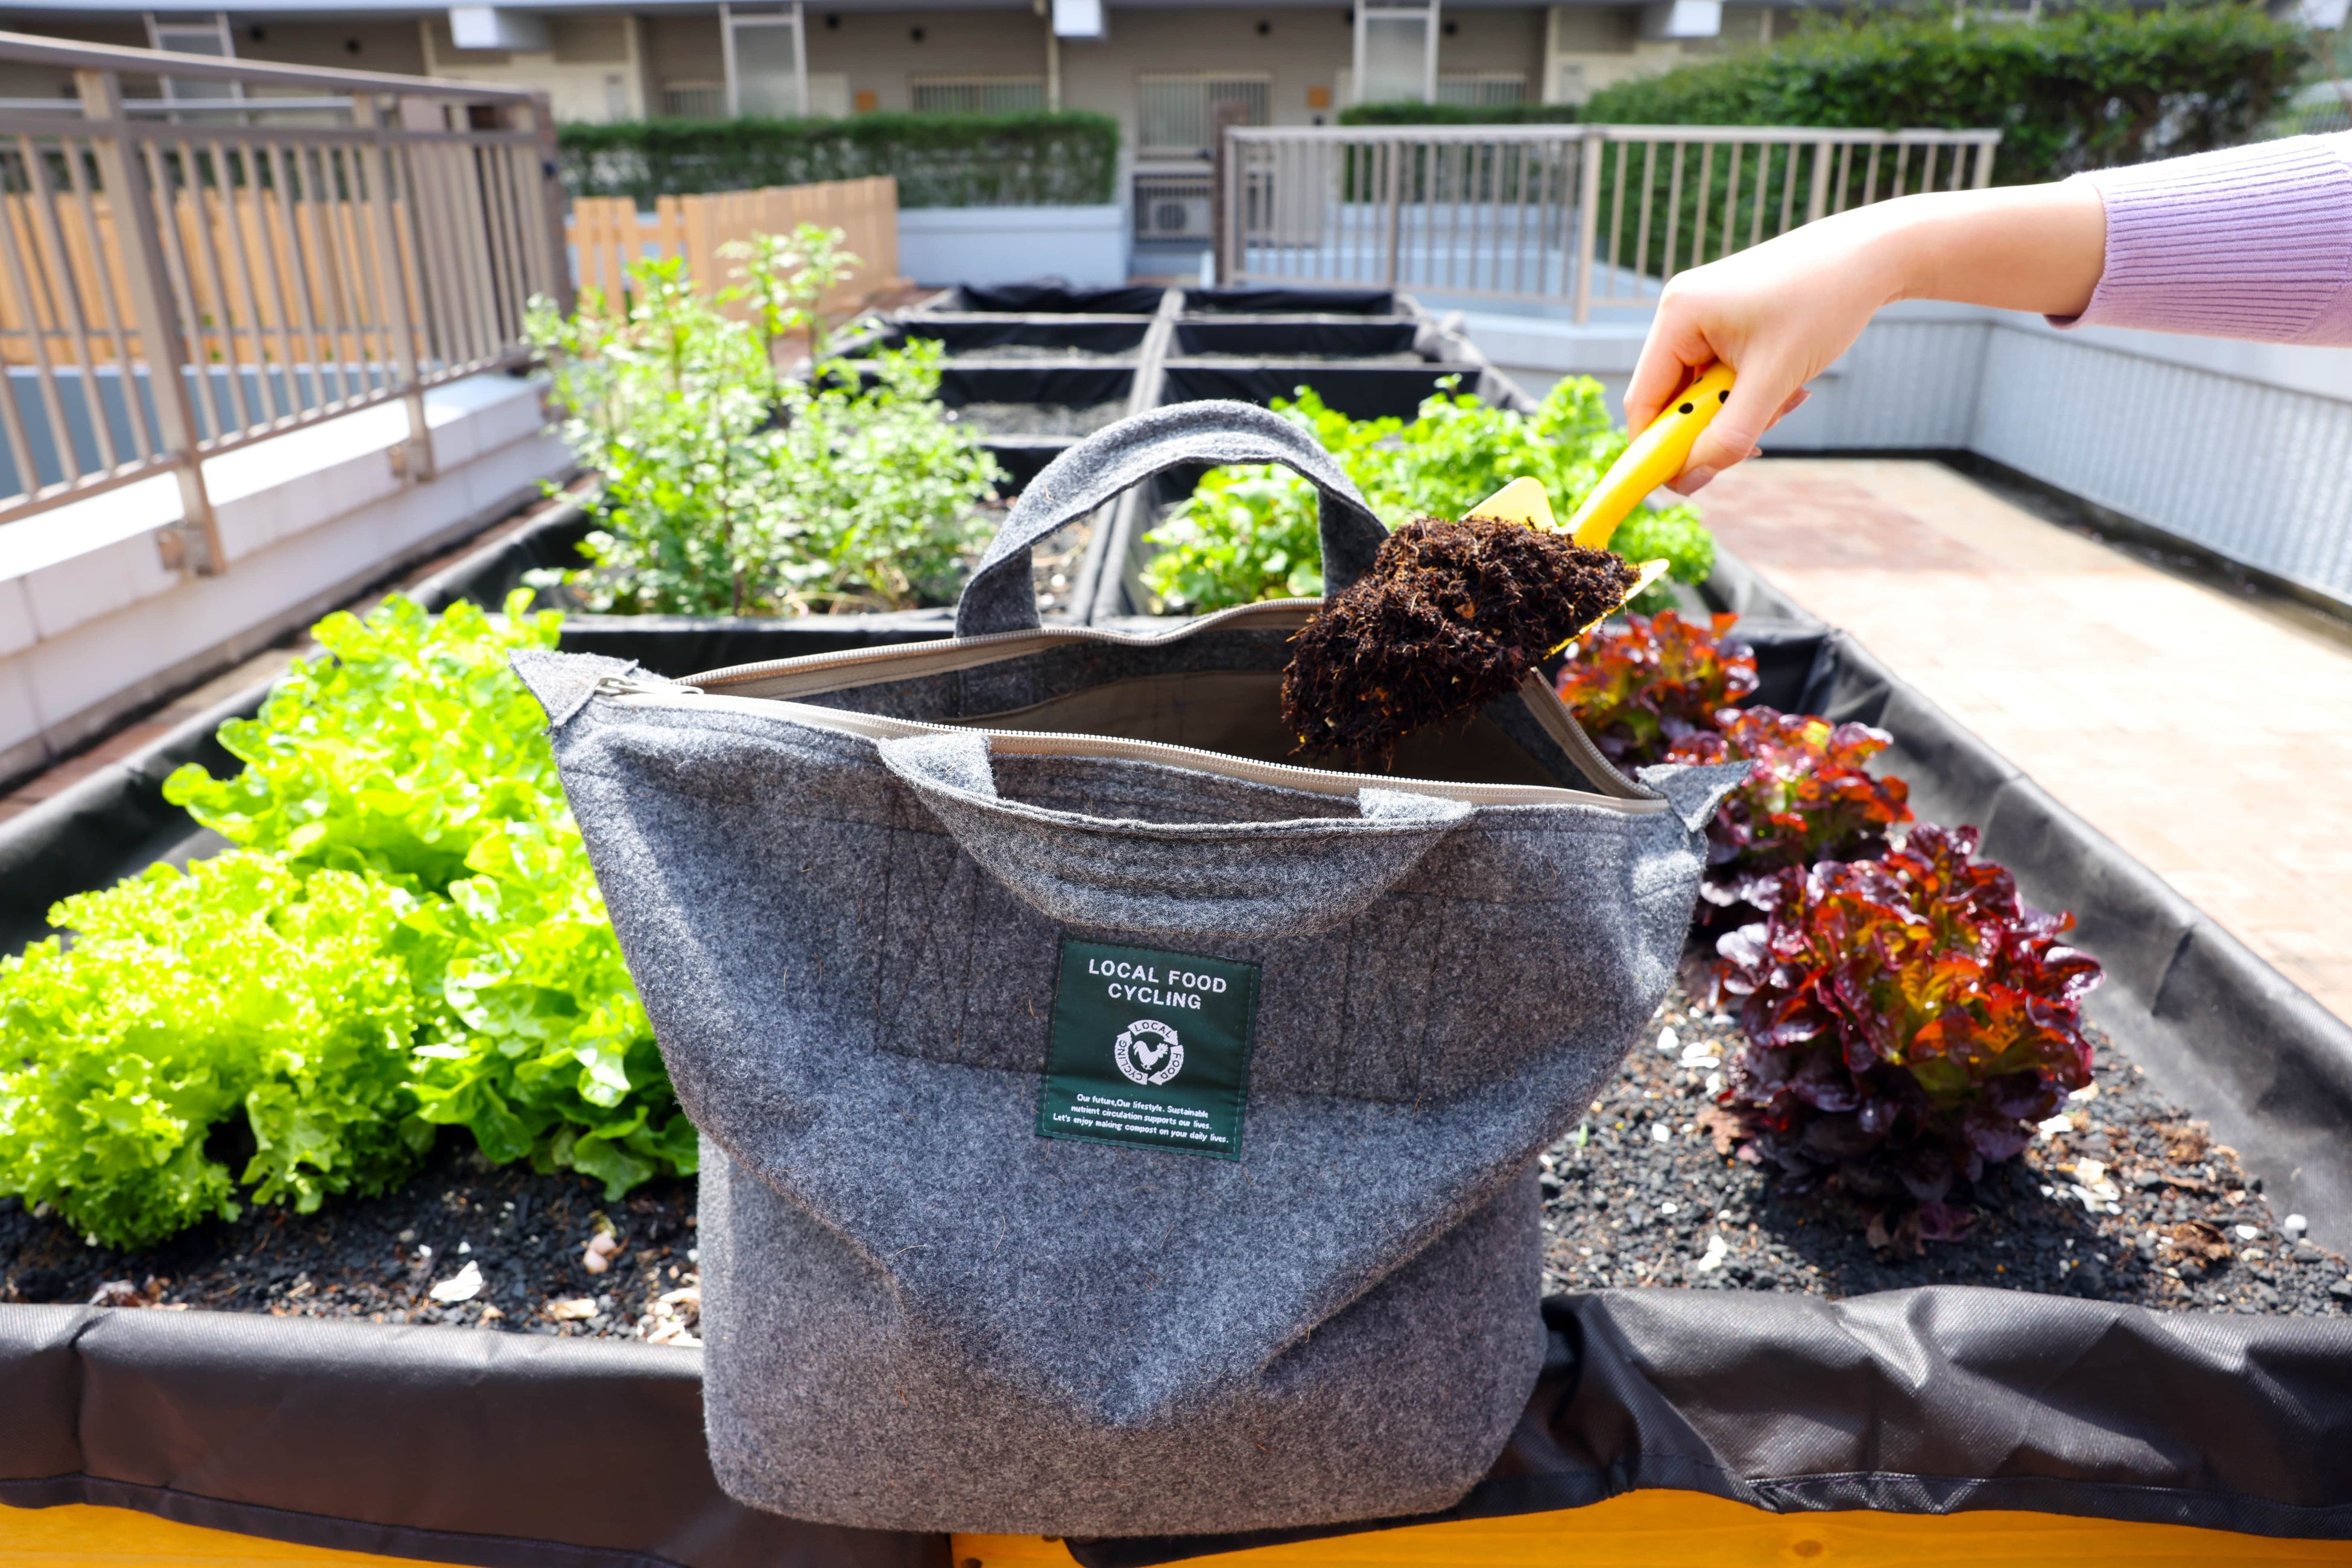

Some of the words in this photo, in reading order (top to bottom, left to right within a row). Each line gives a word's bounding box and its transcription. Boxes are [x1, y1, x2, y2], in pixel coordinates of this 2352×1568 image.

[1089, 958, 1159, 984] LOCAL
[1168, 970, 1227, 993] FOOD
[1108, 982, 1201, 1010] CYCLING
[1134, 1022, 1172, 1038] LOCAL
[1117, 1040, 1143, 1081] CYCLING
[1160, 1052, 1182, 1080] FOOD
[1070, 1105, 1100, 1115] nutrient
[1102, 1108, 1143, 1121] circulation
[1143, 1114, 1177, 1125] supports
[1193, 1120, 1212, 1130] lives.
[1076, 1093, 1091, 1102] Our
[1133, 1101, 1165, 1113] lifestyle.
[1167, 1105, 1209, 1119] Sustainable
[1053, 1113, 1071, 1122] Let's
[1073, 1116, 1093, 1127] enjoy
[1095, 1120, 1123, 1131] making
[1124, 1124, 1157, 1134] compost
[1171, 1130, 1188, 1138] your
[1189, 1131, 1208, 1142] daily
[1210, 1133, 1229, 1143] lives.
